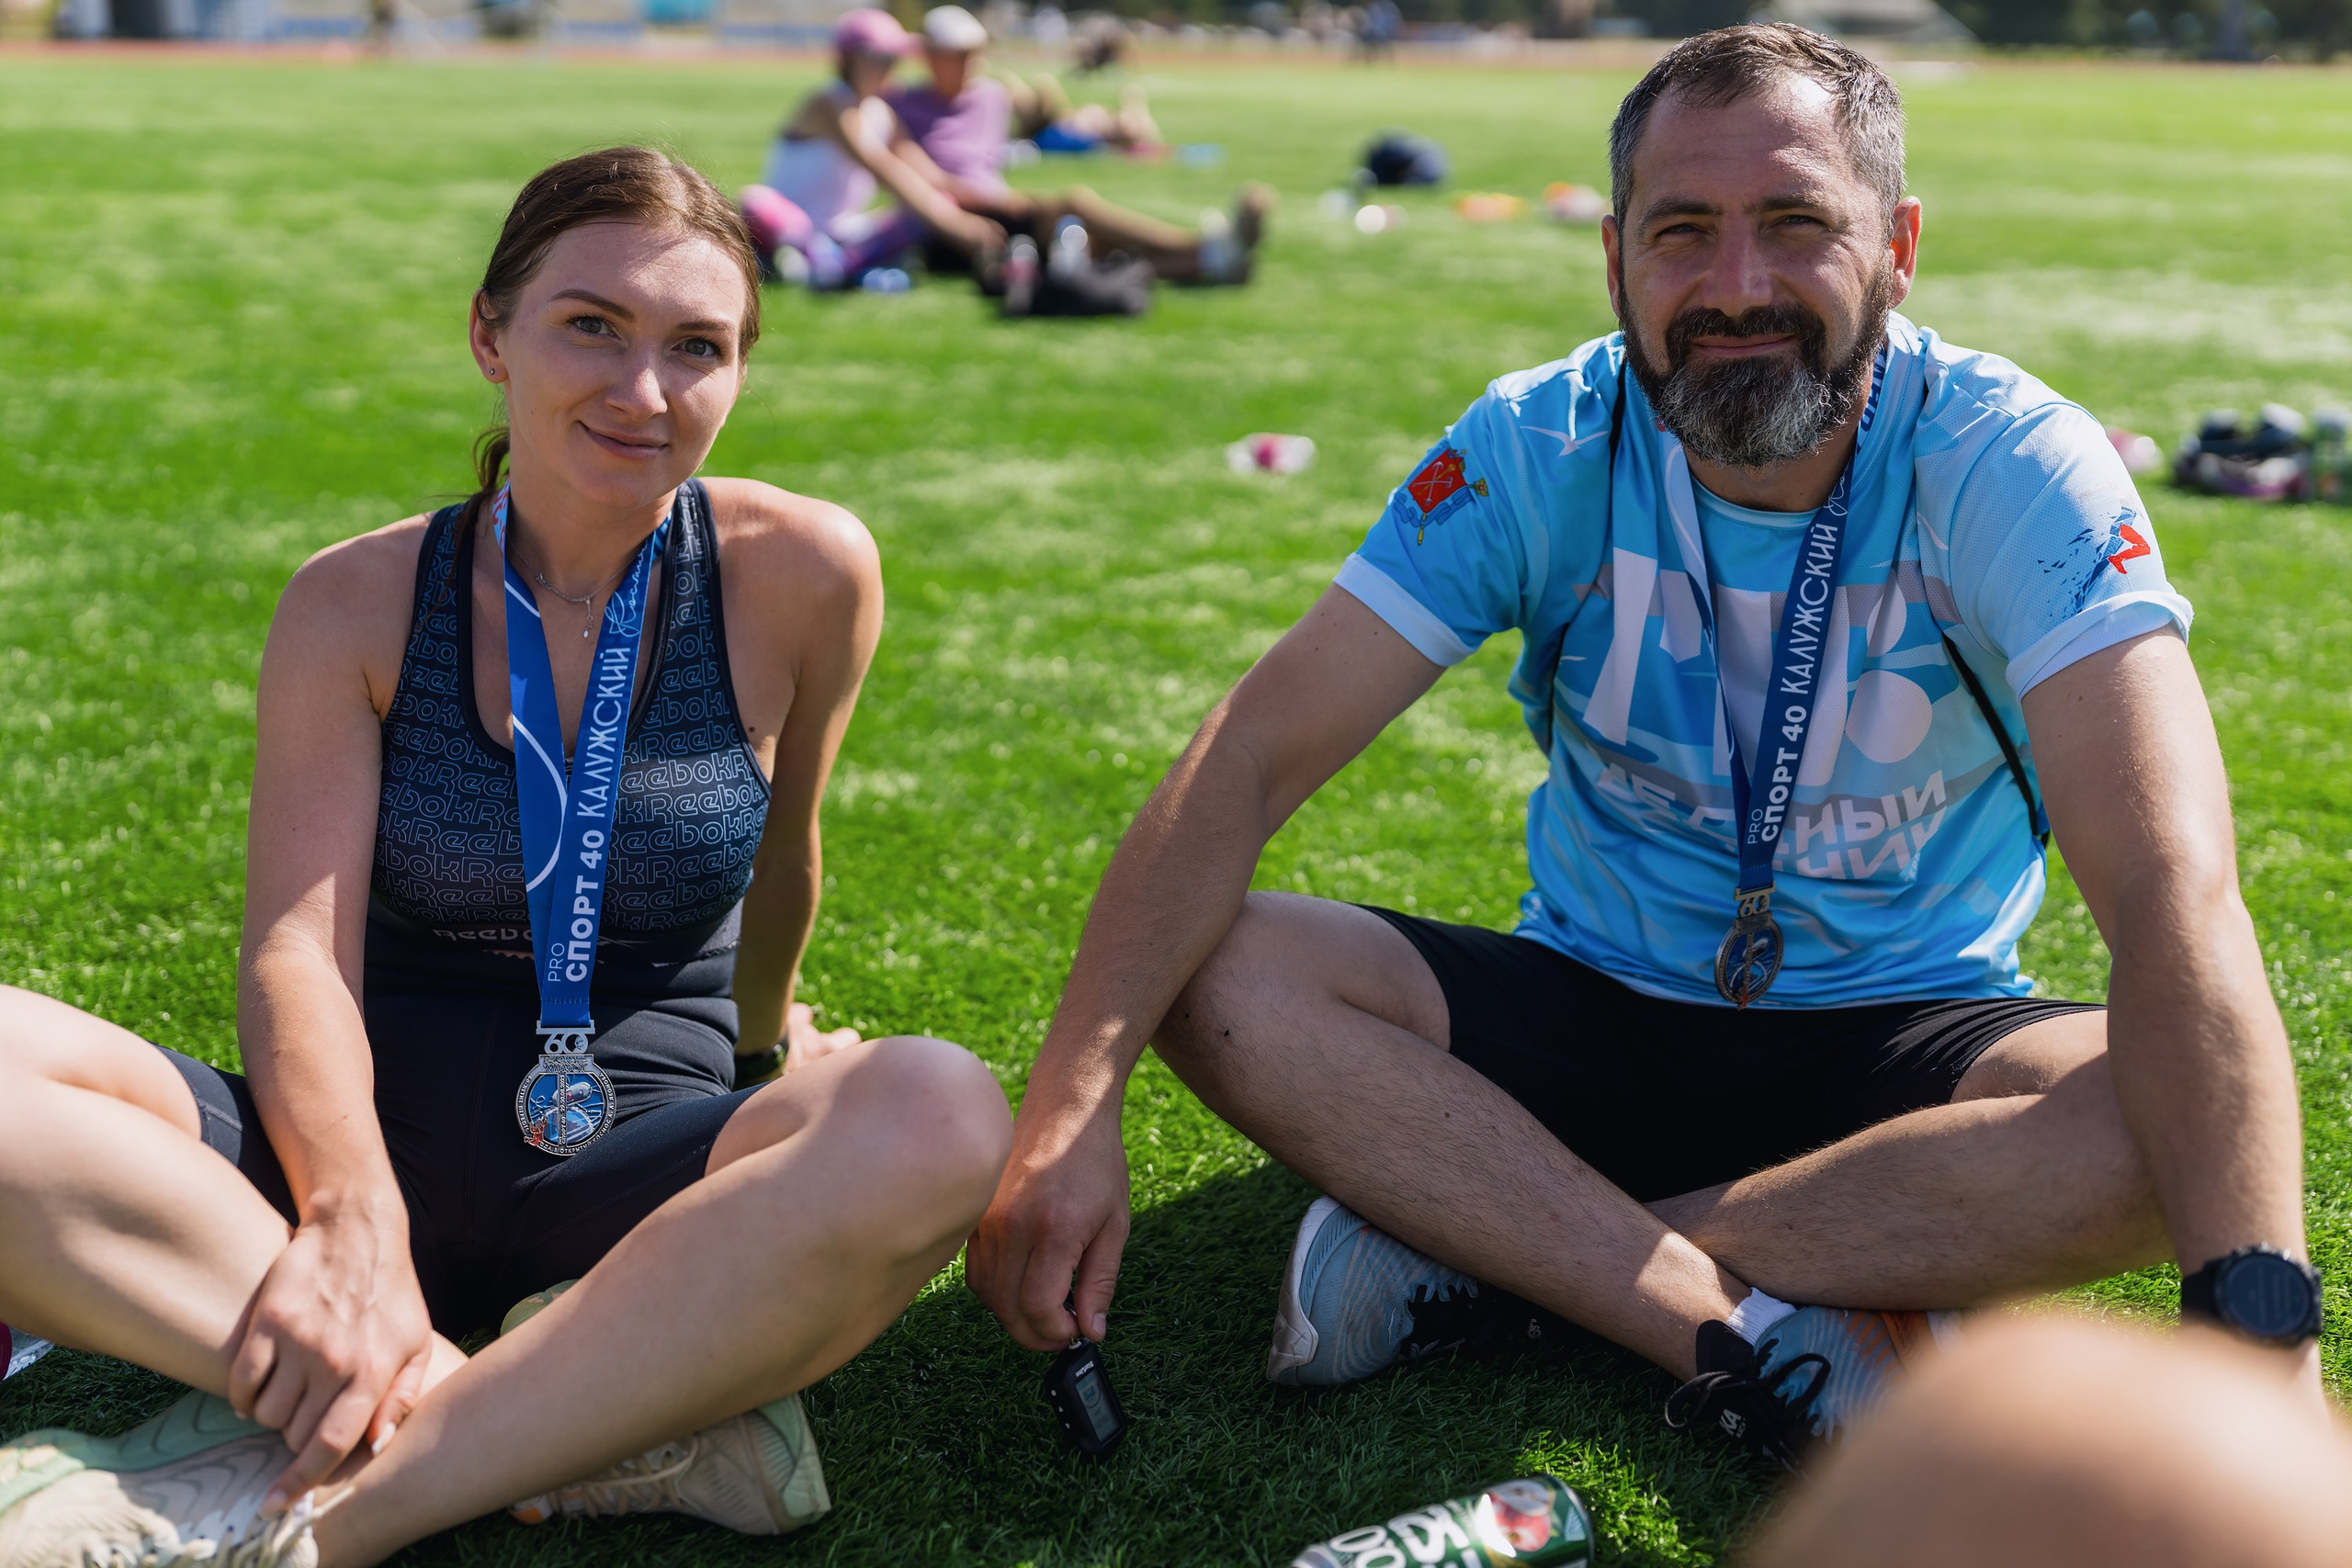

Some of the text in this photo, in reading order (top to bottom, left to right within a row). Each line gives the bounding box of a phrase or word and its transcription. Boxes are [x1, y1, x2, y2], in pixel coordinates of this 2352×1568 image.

[1781, 523, 1838, 694] КАЛУЖСКИЙ
[577, 648, 630, 818] КАЛУЖСКИЙ
[1781, 705, 1807, 742] 40
[1747, 808, 1763, 844] PRO
[1761, 748, 1798, 841] СПОРТ
[580, 829, 605, 869] 40
[548, 942, 565, 981] PRO
[565, 875, 599, 982] СПОРТ
